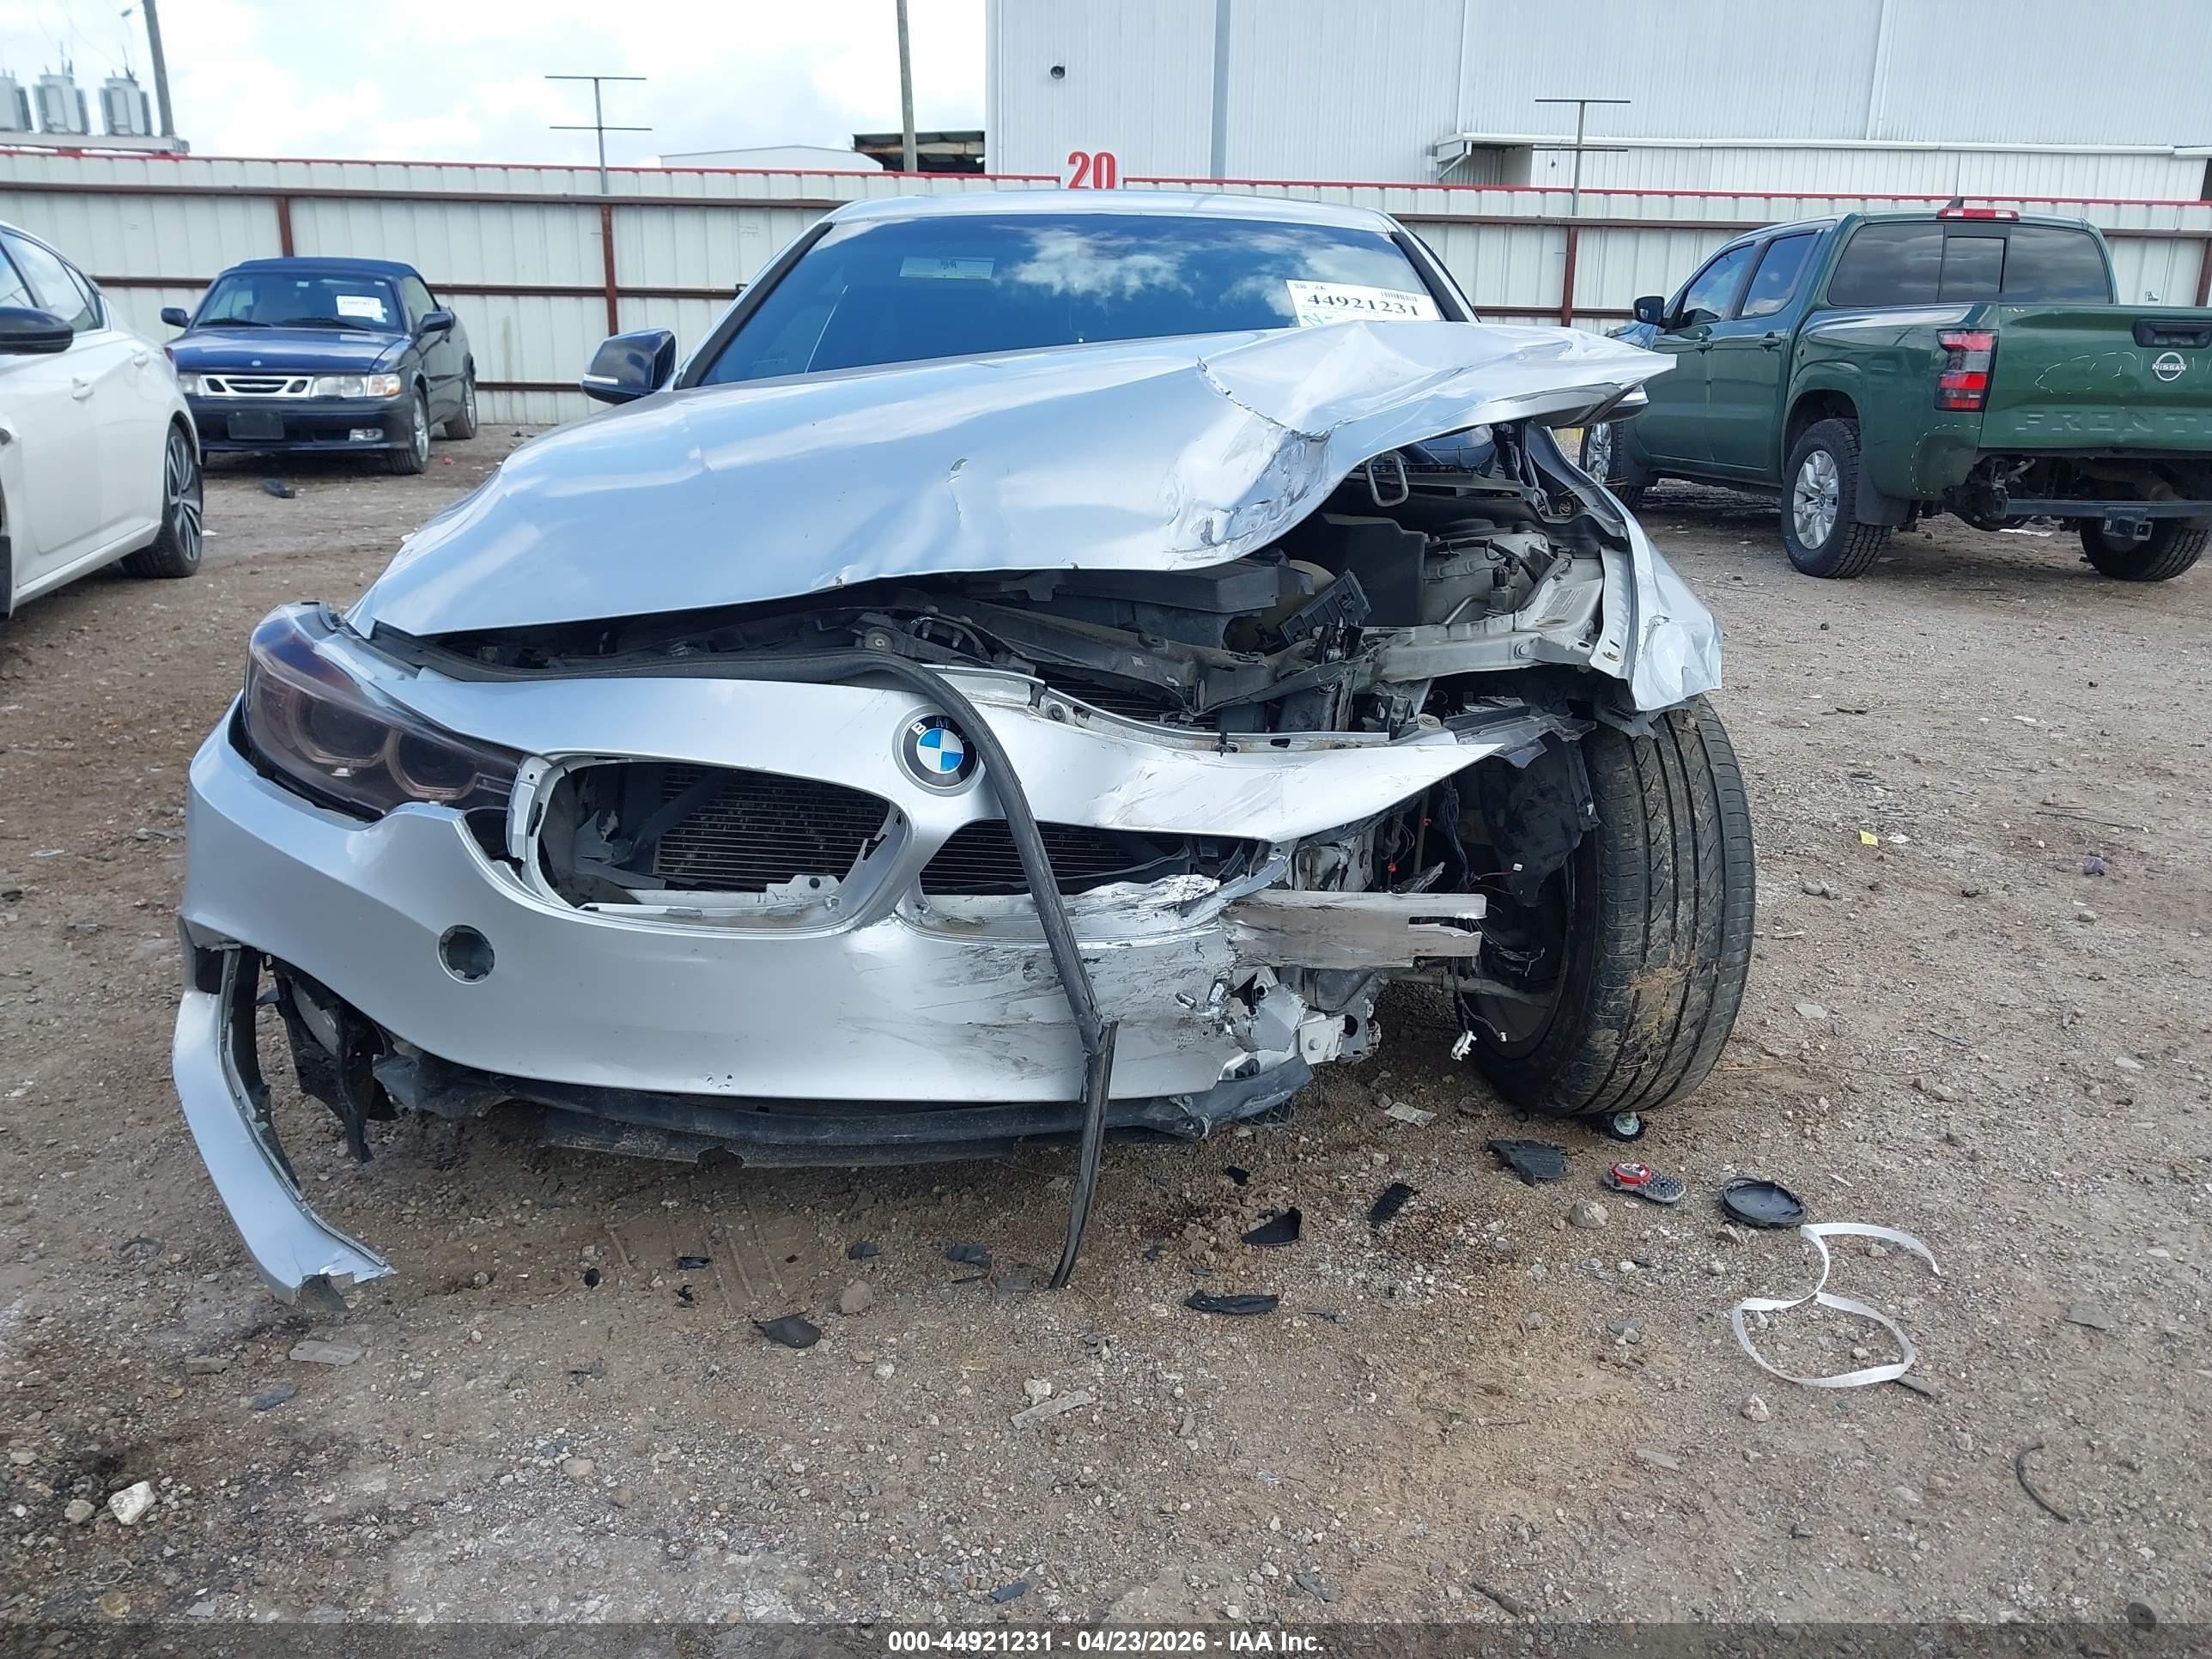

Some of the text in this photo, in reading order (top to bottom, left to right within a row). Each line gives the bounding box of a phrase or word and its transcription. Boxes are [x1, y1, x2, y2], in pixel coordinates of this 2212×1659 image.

[1067, 150, 1116, 190] 20
[1306, 294, 1419, 317] 44921231
[2152, 362, 2187, 371] NISSAN
